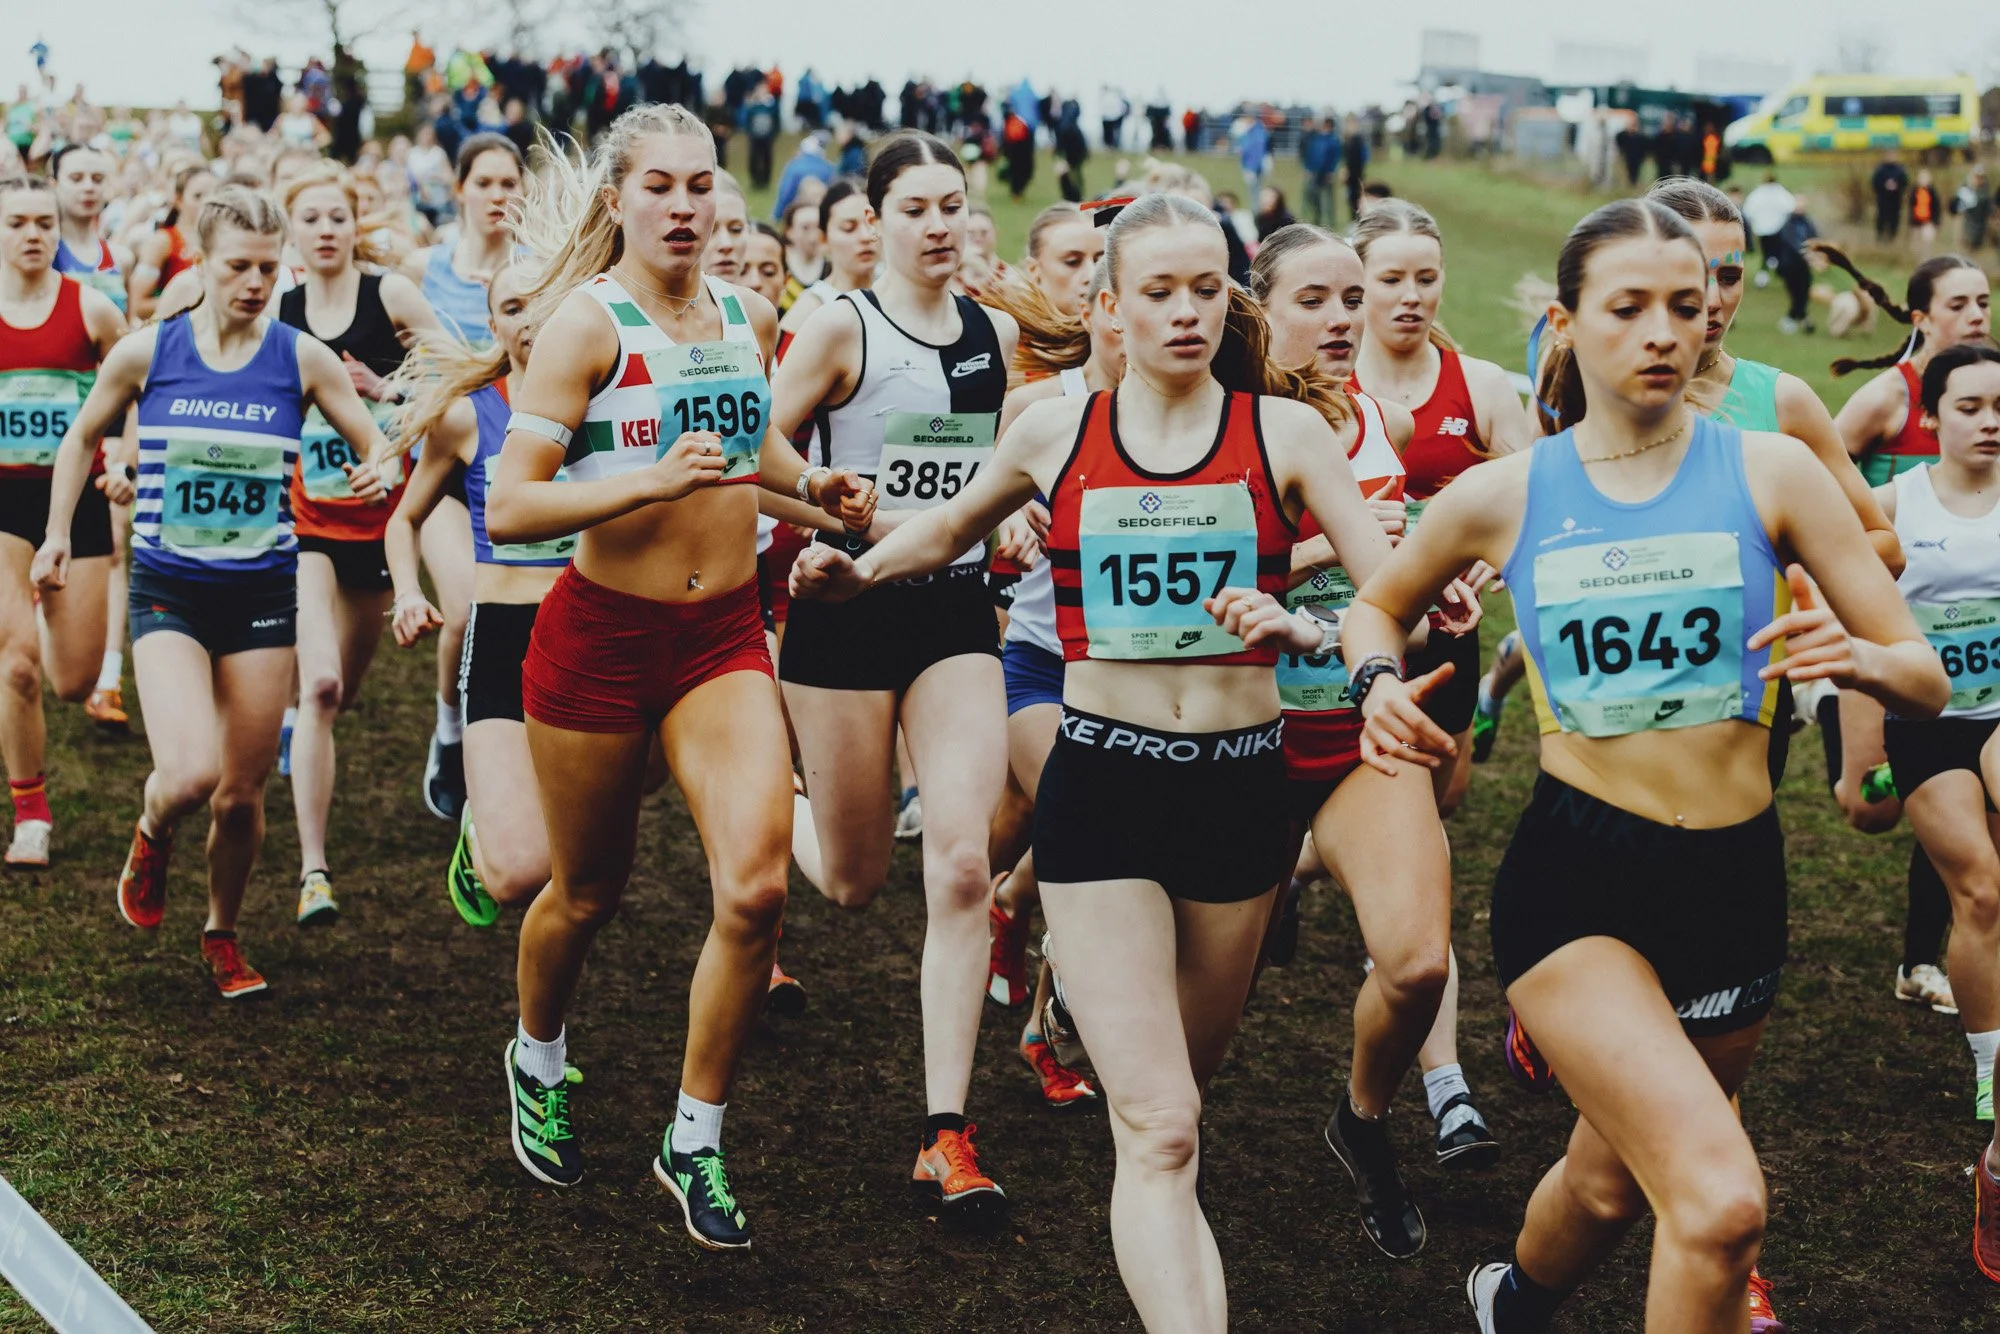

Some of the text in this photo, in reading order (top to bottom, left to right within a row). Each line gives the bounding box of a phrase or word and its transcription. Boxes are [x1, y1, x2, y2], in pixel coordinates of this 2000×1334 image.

[679, 364, 740, 378] SEDGEFIELD
[0, 410, 70, 438] 1595
[168, 398, 278, 423] BINGLEY
[673, 390, 761, 438] 1596
[621, 418, 662, 448] KEI
[913, 434, 974, 444] SEDGEFIELD
[176, 480, 267, 516] 1548
[1118, 516, 1217, 528] SEDGEFIELD
[1100, 550, 1237, 607] 1557
[1579, 568, 1694, 589] SEDGEFIELD
[1294, 590, 1357, 605] SEDGEFIEL
[1559, 606, 1721, 676] 1643
[1932, 636, 2000, 678] 663
[1103, 727, 1200, 762] PRO
[1213, 717, 1285, 761] NIKE
